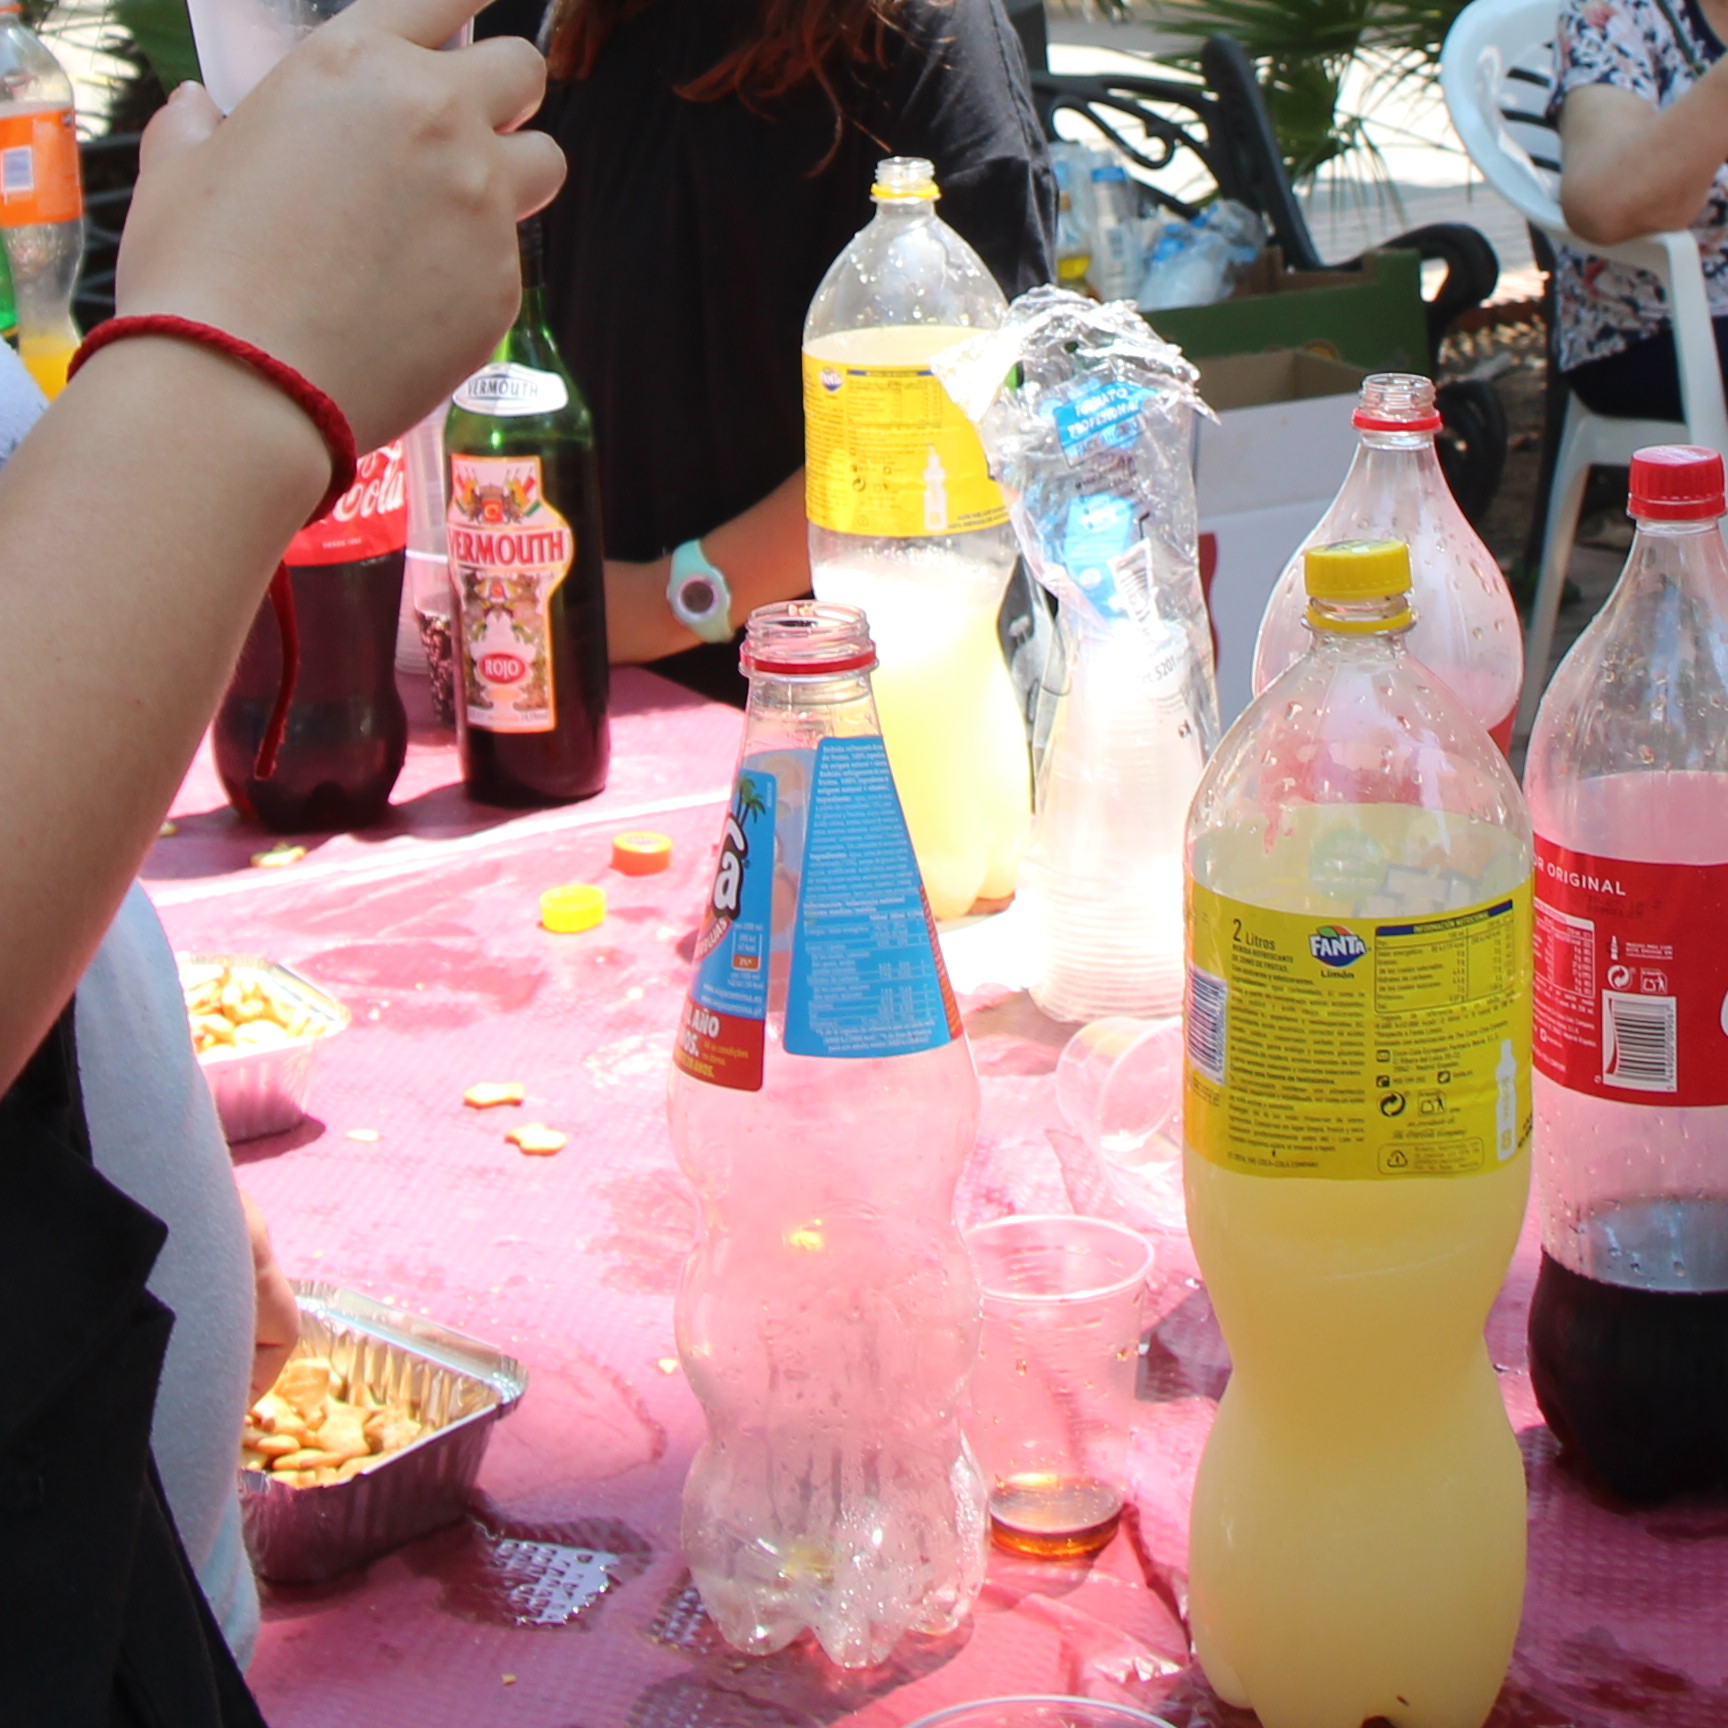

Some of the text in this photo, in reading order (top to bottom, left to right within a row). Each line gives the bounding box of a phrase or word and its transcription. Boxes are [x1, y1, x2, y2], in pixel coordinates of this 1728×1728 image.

[467, 378, 539, 400] VERMOUTH
[448, 528, 565, 567] VERMOUTH
[484, 659, 519, 680] ROJO
[1547, 864, 1627, 897] ORIGINAL
[1232, 918, 1277, 951] 2 Litros
[1309, 933, 1366, 958] FANTA
[692, 1007, 720, 1039] AÑO
